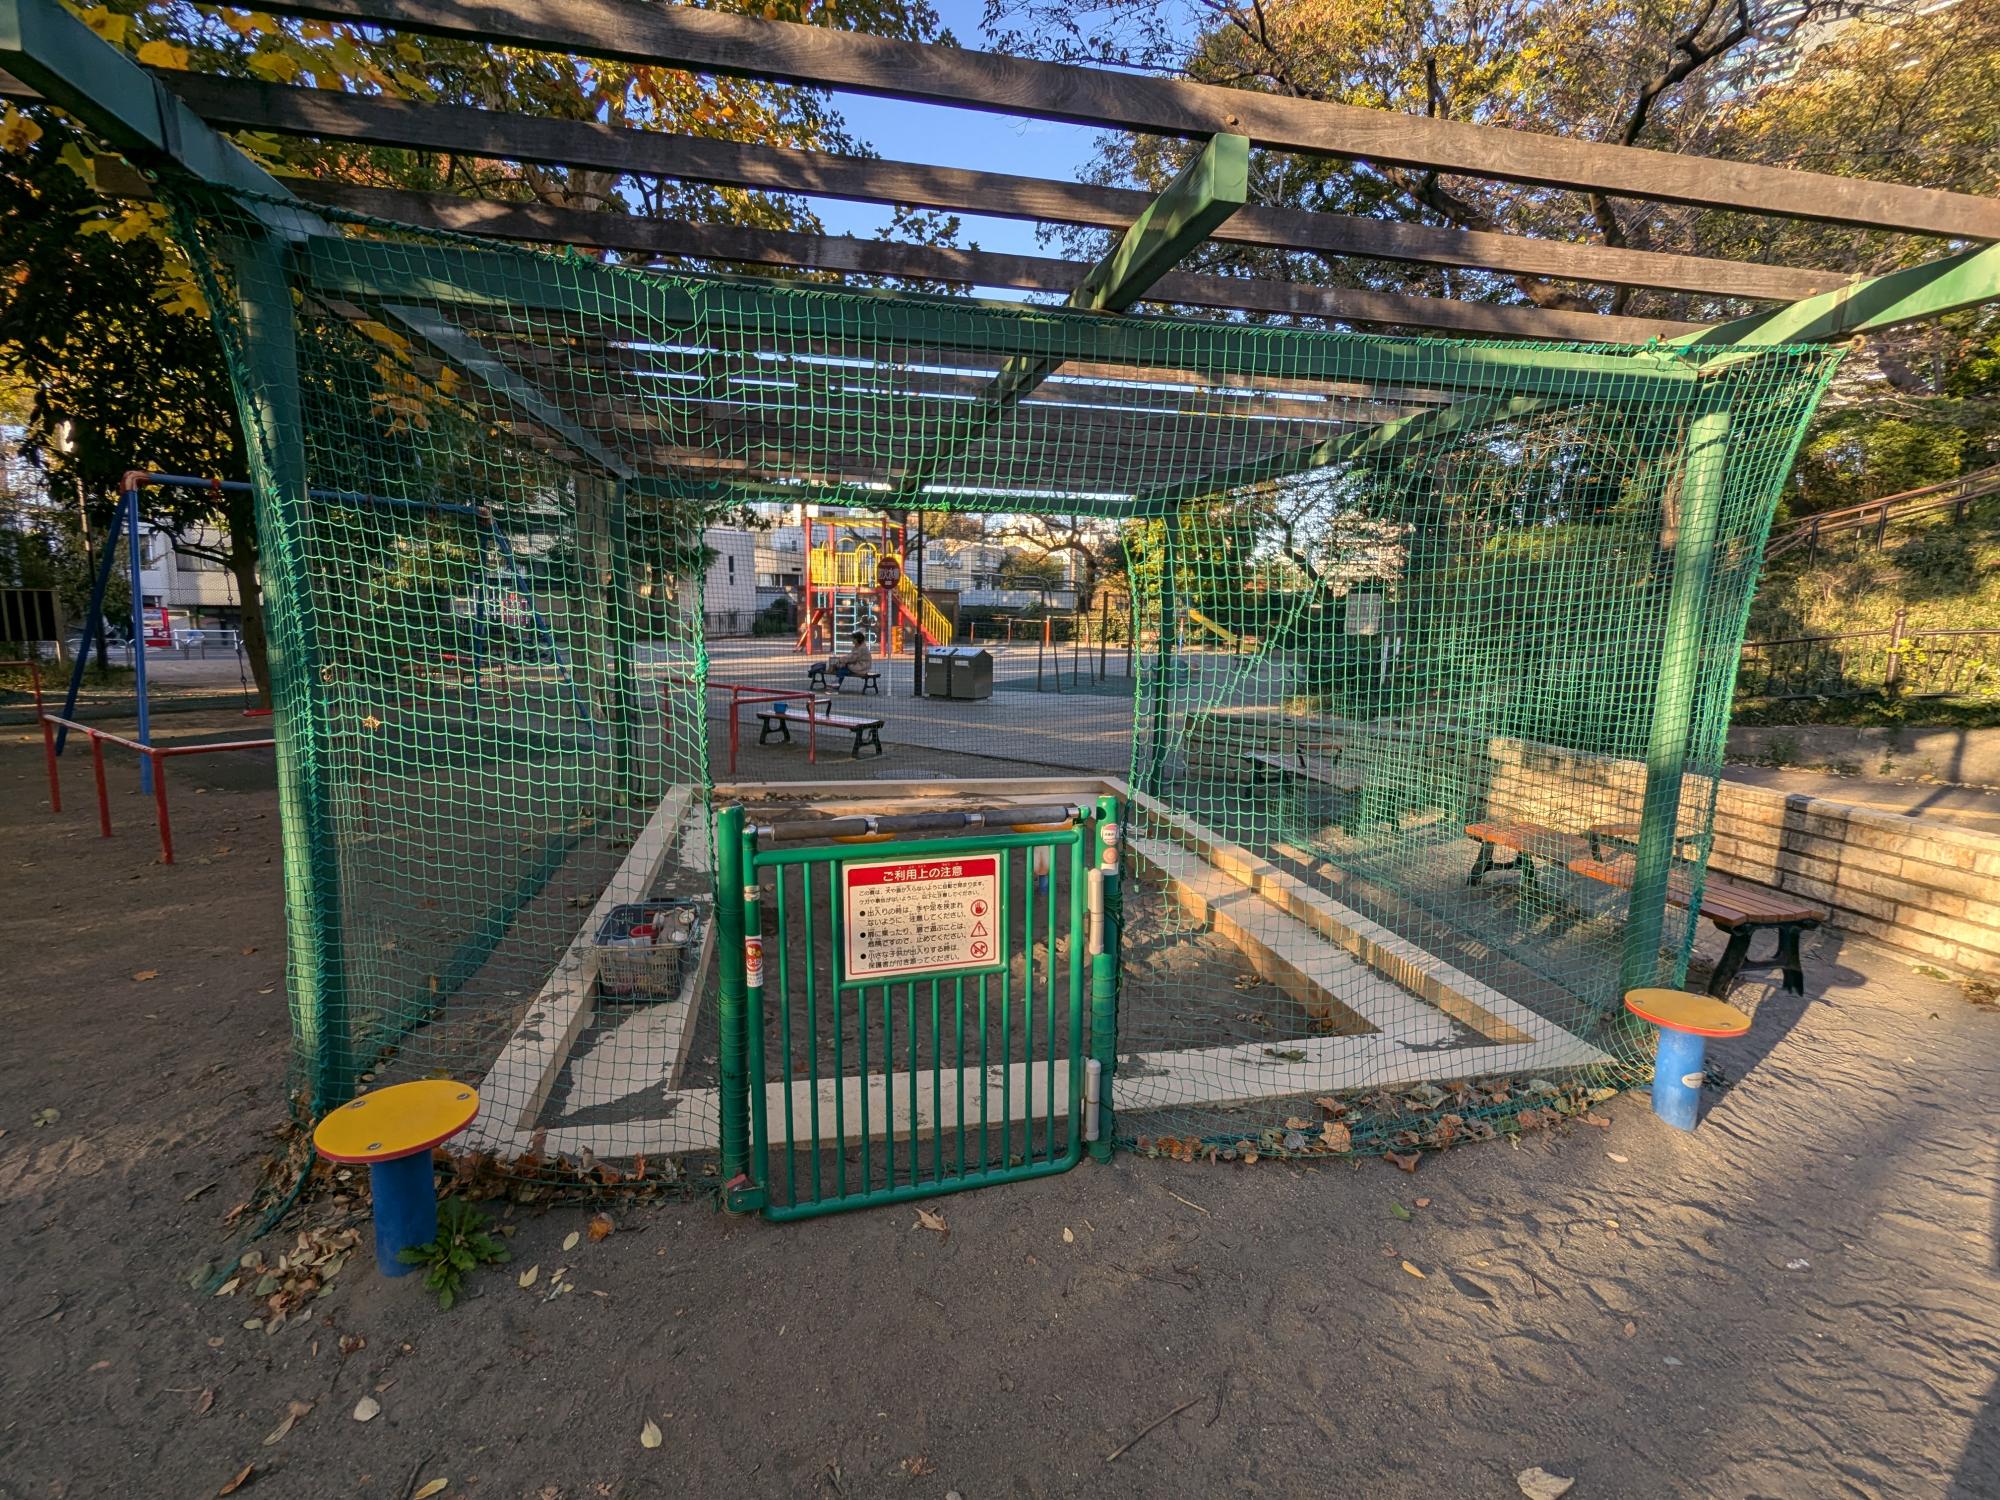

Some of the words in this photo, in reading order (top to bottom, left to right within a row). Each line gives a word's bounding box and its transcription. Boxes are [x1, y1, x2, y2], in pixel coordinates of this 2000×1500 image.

[883, 865, 963, 882] ご利用上の注意
[867, 913, 967, 926] ないように、注意してください。
